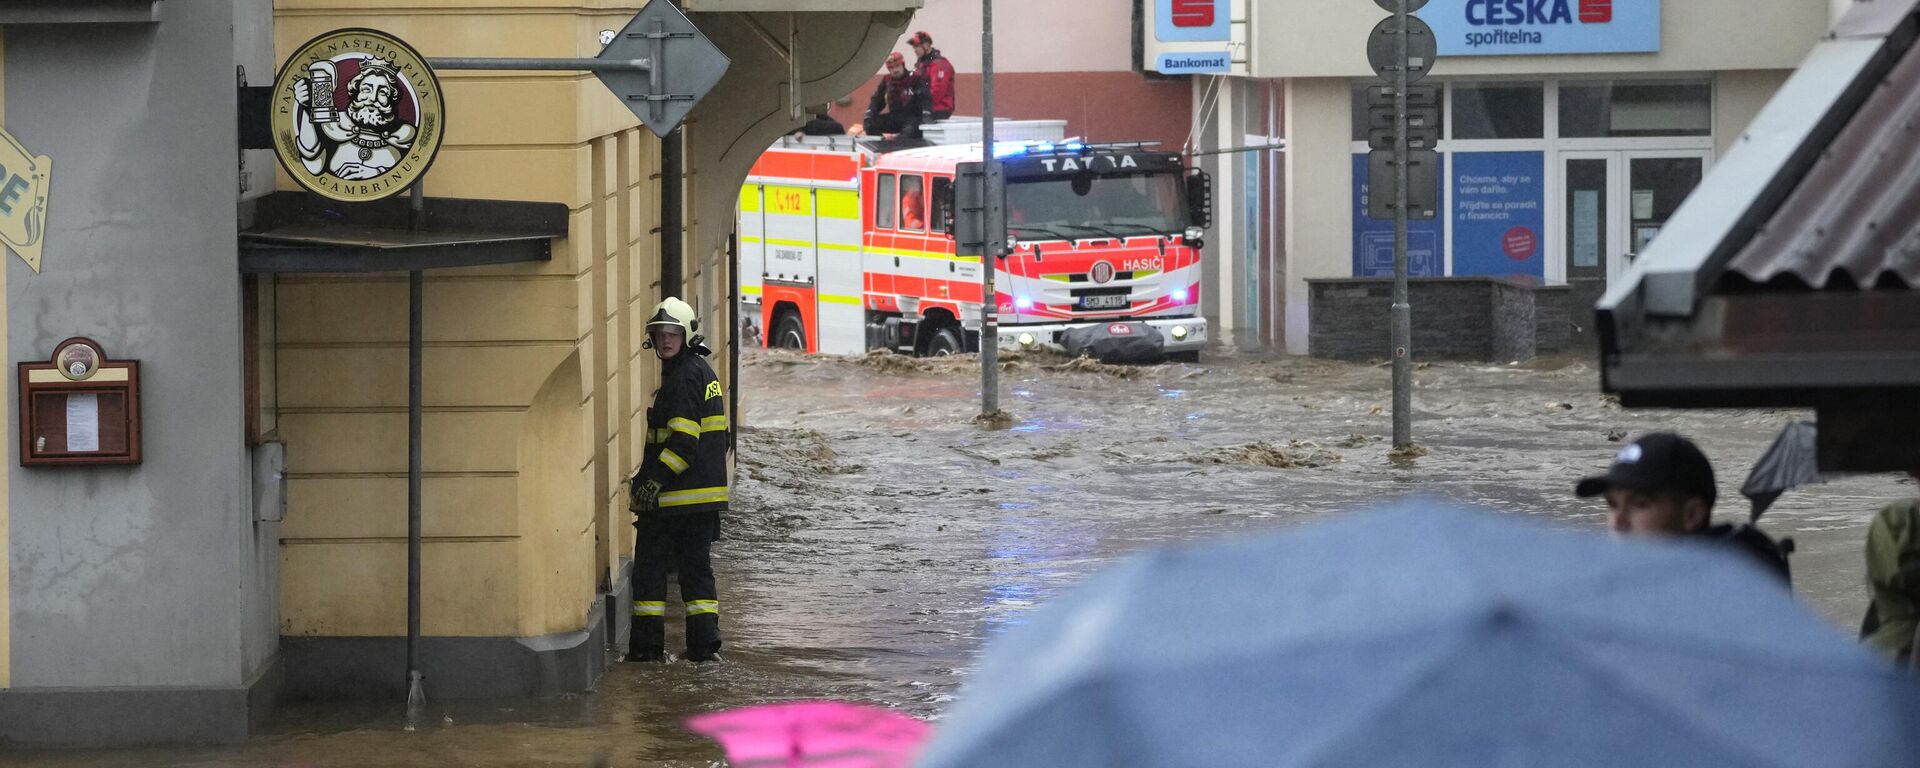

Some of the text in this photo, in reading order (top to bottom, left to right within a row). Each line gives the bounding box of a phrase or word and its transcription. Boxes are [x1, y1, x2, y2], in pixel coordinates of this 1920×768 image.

[1465, 29, 1542, 47] spořitelna
[1164, 58, 1225, 68] Bankomat
[404, 63, 430, 99] PIVA
[318, 153, 420, 195] GAMBRINUS
[785, 192, 801, 210] 112
